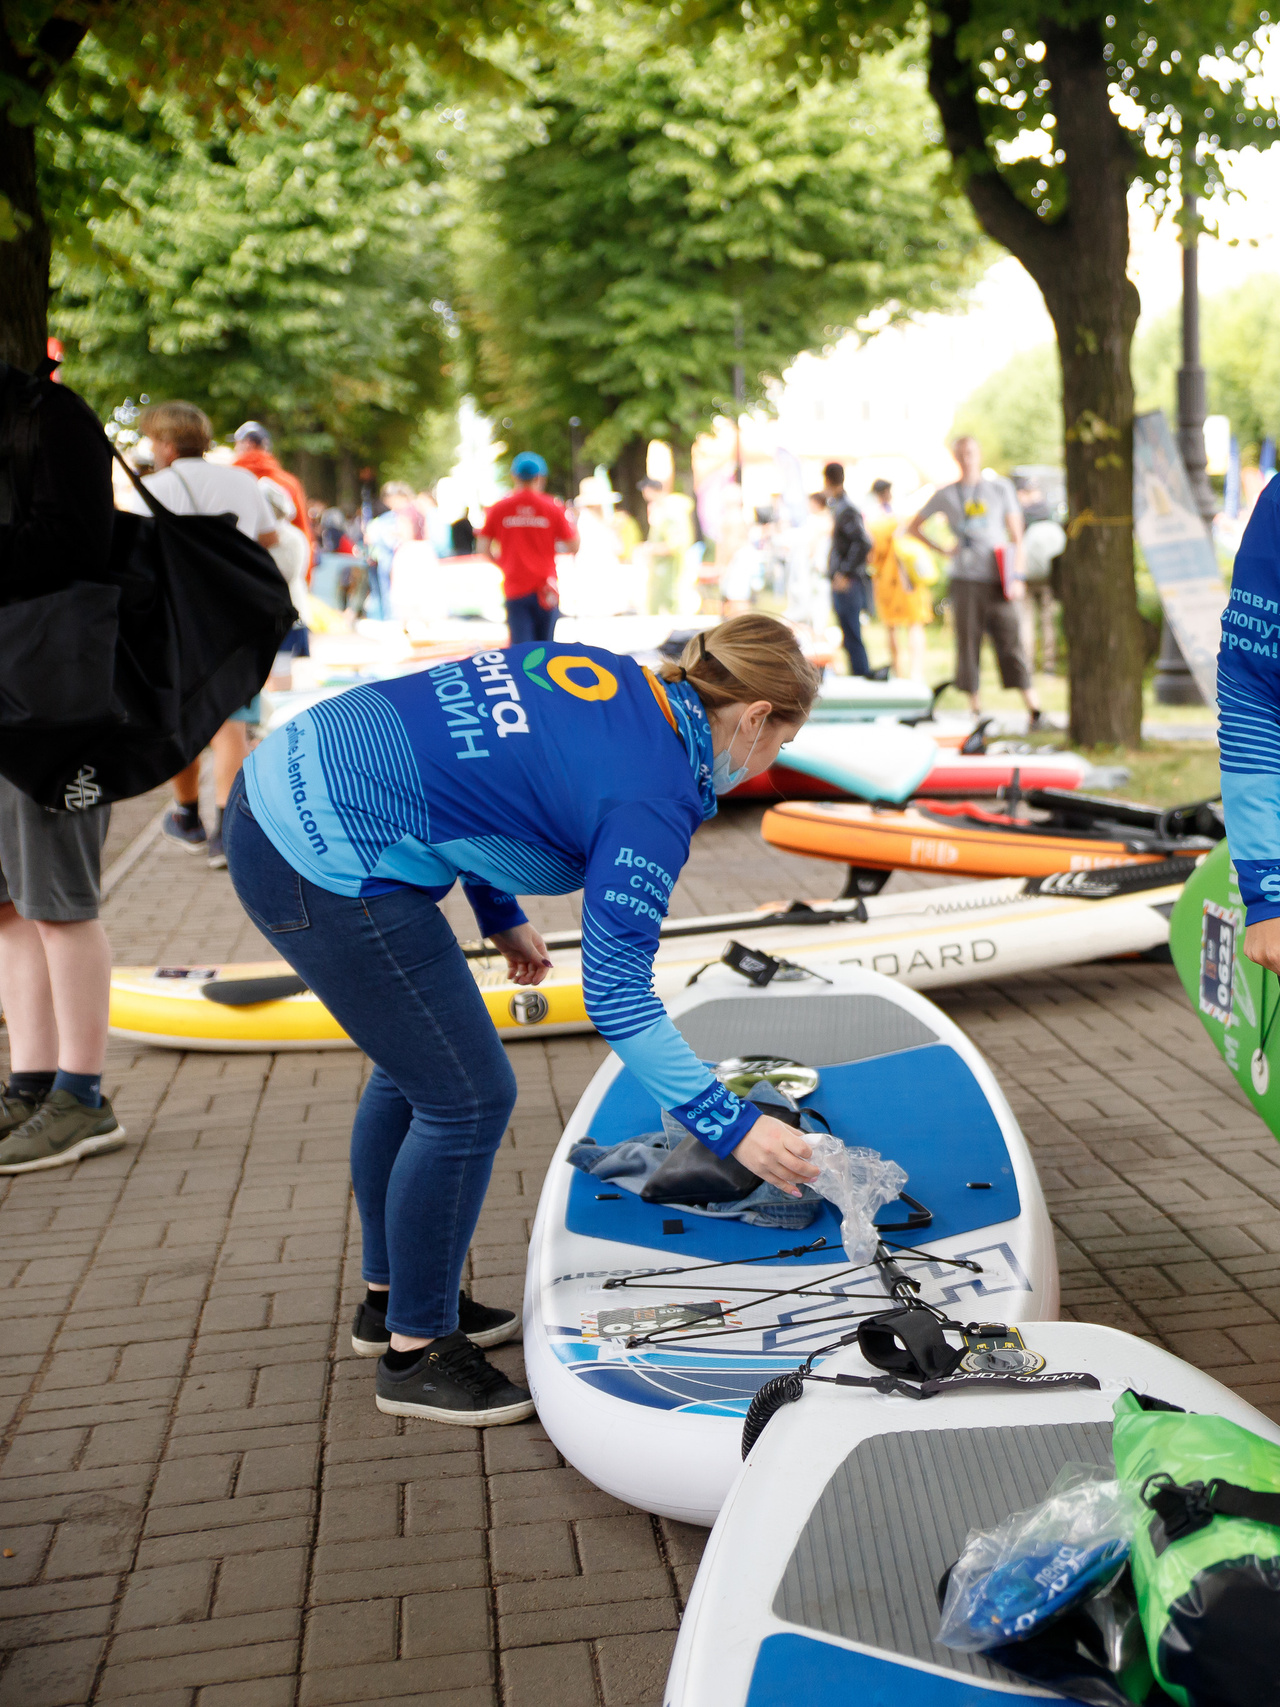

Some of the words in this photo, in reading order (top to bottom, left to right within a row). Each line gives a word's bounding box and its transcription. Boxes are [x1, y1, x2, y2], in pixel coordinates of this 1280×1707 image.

[472, 649, 530, 738] ента
[285, 721, 329, 856] online.lenta.com
[839, 940, 997, 976] OARD
[1216, 924, 1233, 1007] 0623
